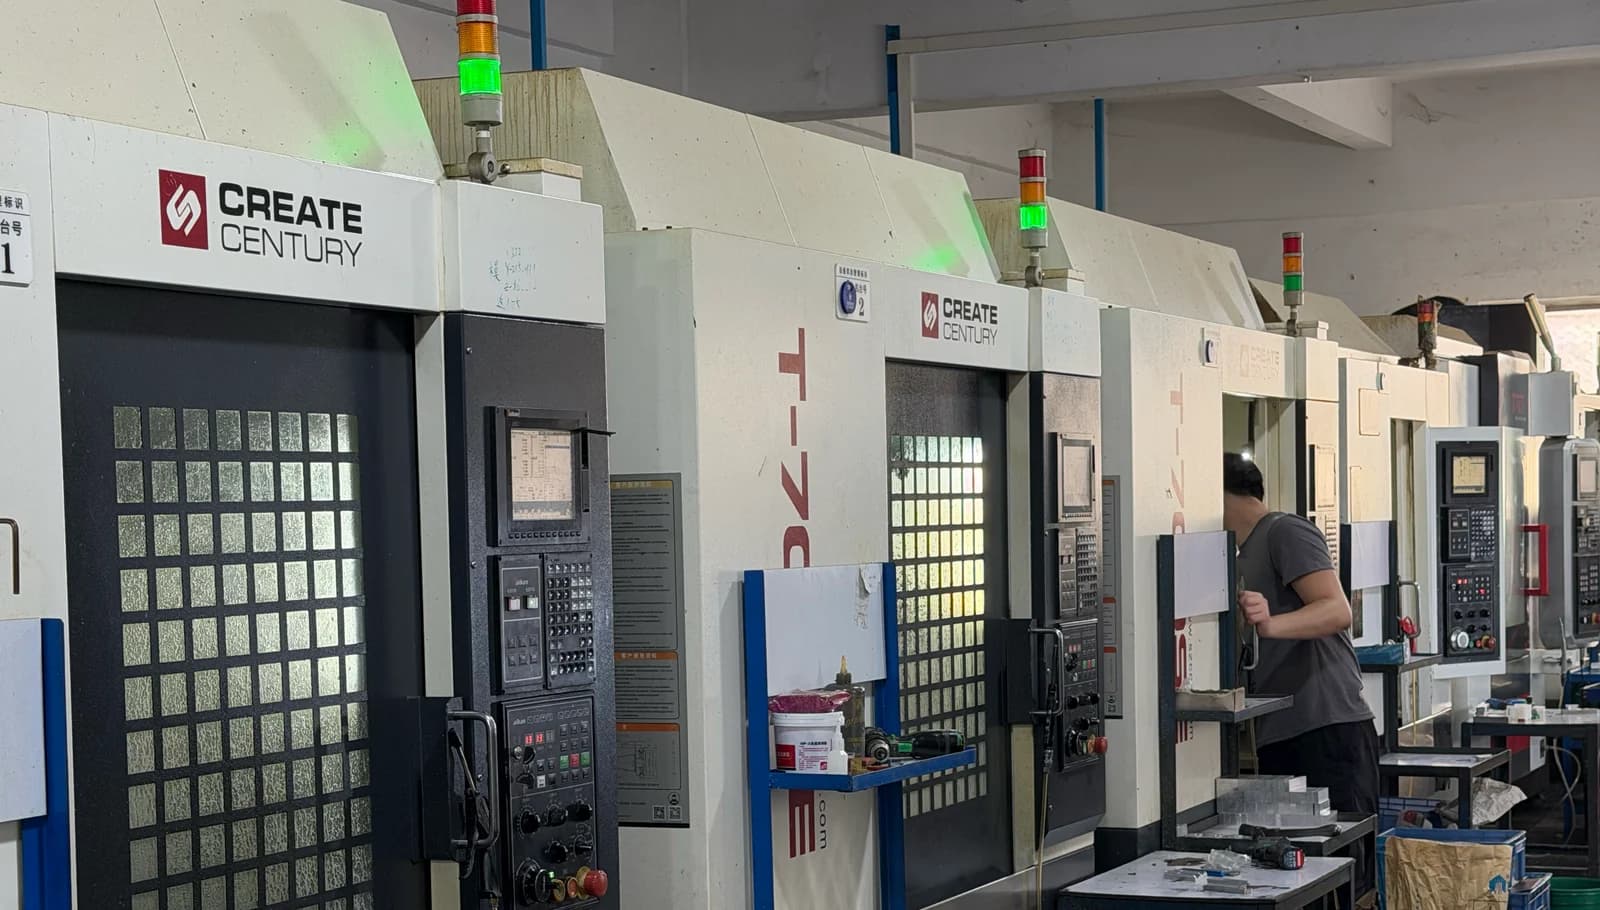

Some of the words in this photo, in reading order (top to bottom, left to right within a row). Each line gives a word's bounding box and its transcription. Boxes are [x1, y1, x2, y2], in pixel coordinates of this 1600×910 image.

[0, 195, 24, 209] 标识
[219, 182, 363, 234] CREATE
[1, 242, 15, 274] 1
[221, 223, 363, 267] CENTURY
[858, 297, 865, 316] 2
[943, 297, 998, 325] CREATE
[943, 322, 998, 345] CENTURY
